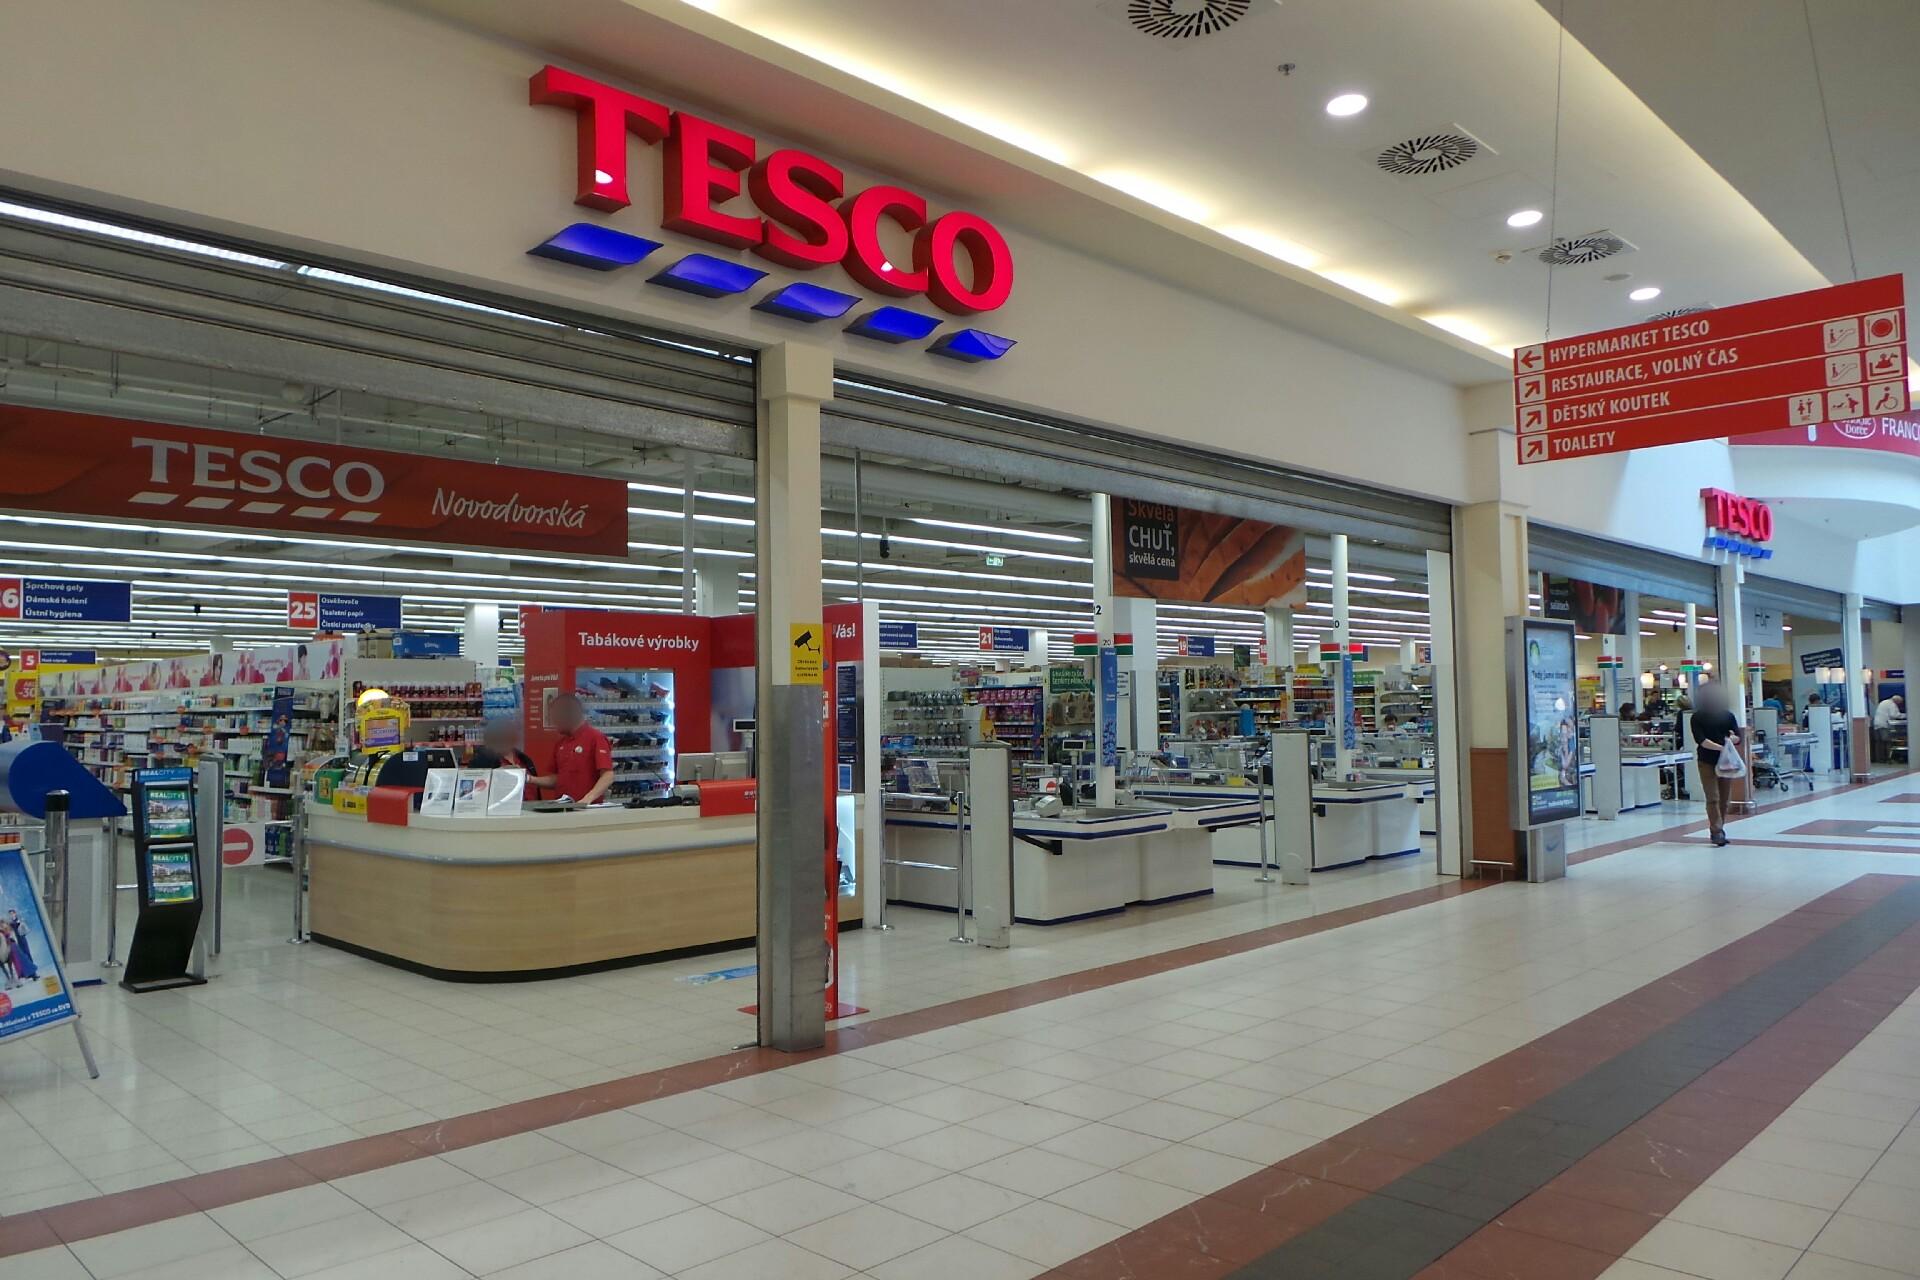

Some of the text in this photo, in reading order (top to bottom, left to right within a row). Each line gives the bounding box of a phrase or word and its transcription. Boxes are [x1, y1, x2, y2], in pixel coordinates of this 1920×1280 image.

[529, 64, 1014, 317] TESCO
[1550, 319, 1710, 363] HYPERMARKET TESCO
[1551, 346, 1739, 393] RESTAURACE, VOLNÝ ČAS
[1552, 391, 1670, 424] DĚTSKÝ KOUTEK
[1553, 431, 1616, 453] TOALETY
[1882, 416, 1920, 441] FRANC
[131, 437, 385, 502] TESCO
[432, 487, 588, 529] Novodvorská
[1700, 487, 1773, 543] TESCO
[1129, 523, 1175, 556] CHUŤ,
[1129, 551, 1176, 567] skvělá cena
[0, 588, 18, 608] 6
[291, 602, 316, 619] 25
[578, 631, 699, 652] Tabákové výrobky
[981, 633, 991, 644] 21
[25, 655, 34, 666] 5
